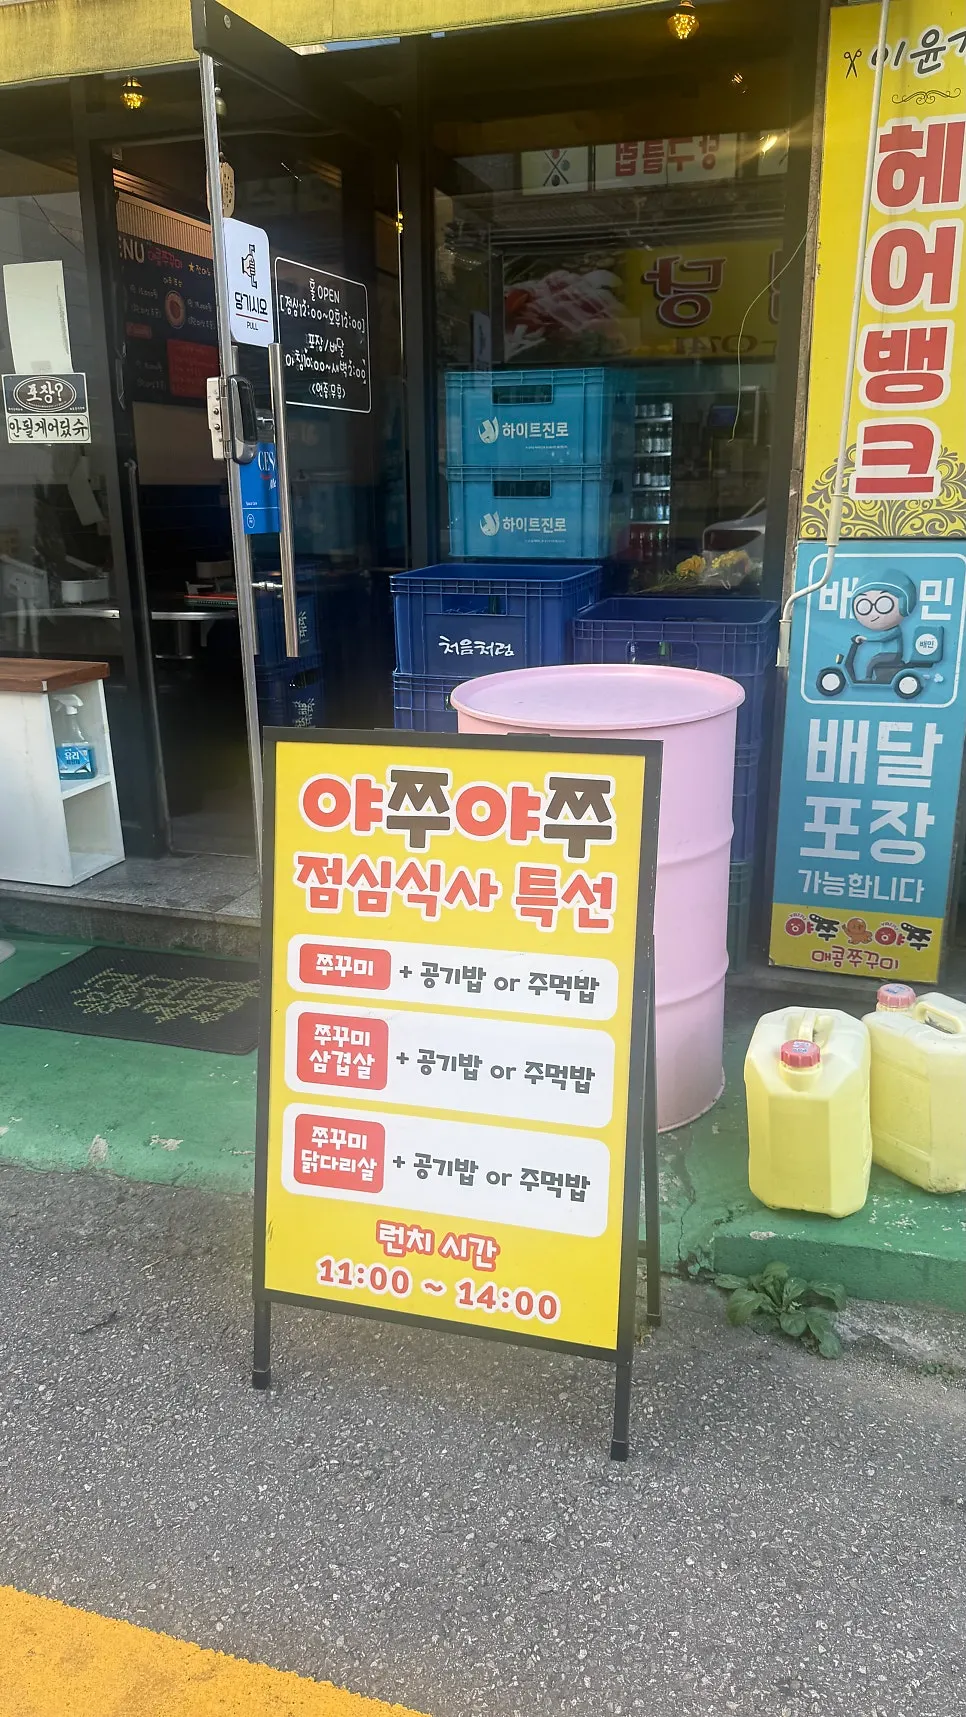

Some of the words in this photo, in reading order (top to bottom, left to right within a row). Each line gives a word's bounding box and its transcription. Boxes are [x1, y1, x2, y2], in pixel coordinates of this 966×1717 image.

[118, 235, 145, 264] NU
[234, 291, 269, 316] 당기시오
[318, 285, 340, 304] OPEN
[855, 121, 966, 494] 헤어뱅크
[246, 321, 259, 331] PULL
[26, 381, 64, 404] 포장?
[502, 421, 569, 439] 하이트진로
[502, 517, 567, 534] 하이트진로
[438, 635, 515, 657] 처음처럼
[919, 640, 935, 649] 배민
[806, 718, 944, 789] 배달
[302, 769, 613, 859] 야쭈야쭈
[799, 795, 936, 865] 포장
[297, 855, 499, 918] 점심식사
[515, 866, 613, 929] 특선
[798, 868, 925, 904] 가능합니다
[812, 945, 899, 970] 매콤쭈꾸미
[315, 953, 374, 978] 쭈꾸미
[420, 961, 487, 993] 공기밥
[494, 975, 520, 991] or
[528, 971, 600, 1004] 주먹밥
[314, 1023, 371, 1048] 쭈꾸미
[309, 1049, 375, 1080] 삼겹살
[417, 1048, 483, 1081] 공기밥
[490, 1064, 516, 1080] or
[524, 1060, 595, 1094] 주먹밥
[311, 1125, 367, 1150] 쭈꾸미
[301, 1149, 377, 1182] 닭다리살
[413, 1152, 479, 1186] 공기밥
[486, 1169, 512, 1187] or
[519, 1167, 590, 1202] 주먹밥
[377, 1220, 433, 1256] 런치
[439, 1233, 499, 1271] 시간
[319, 1258, 410, 1295] 11:00
[458, 1280, 557, 1320] 14:00
